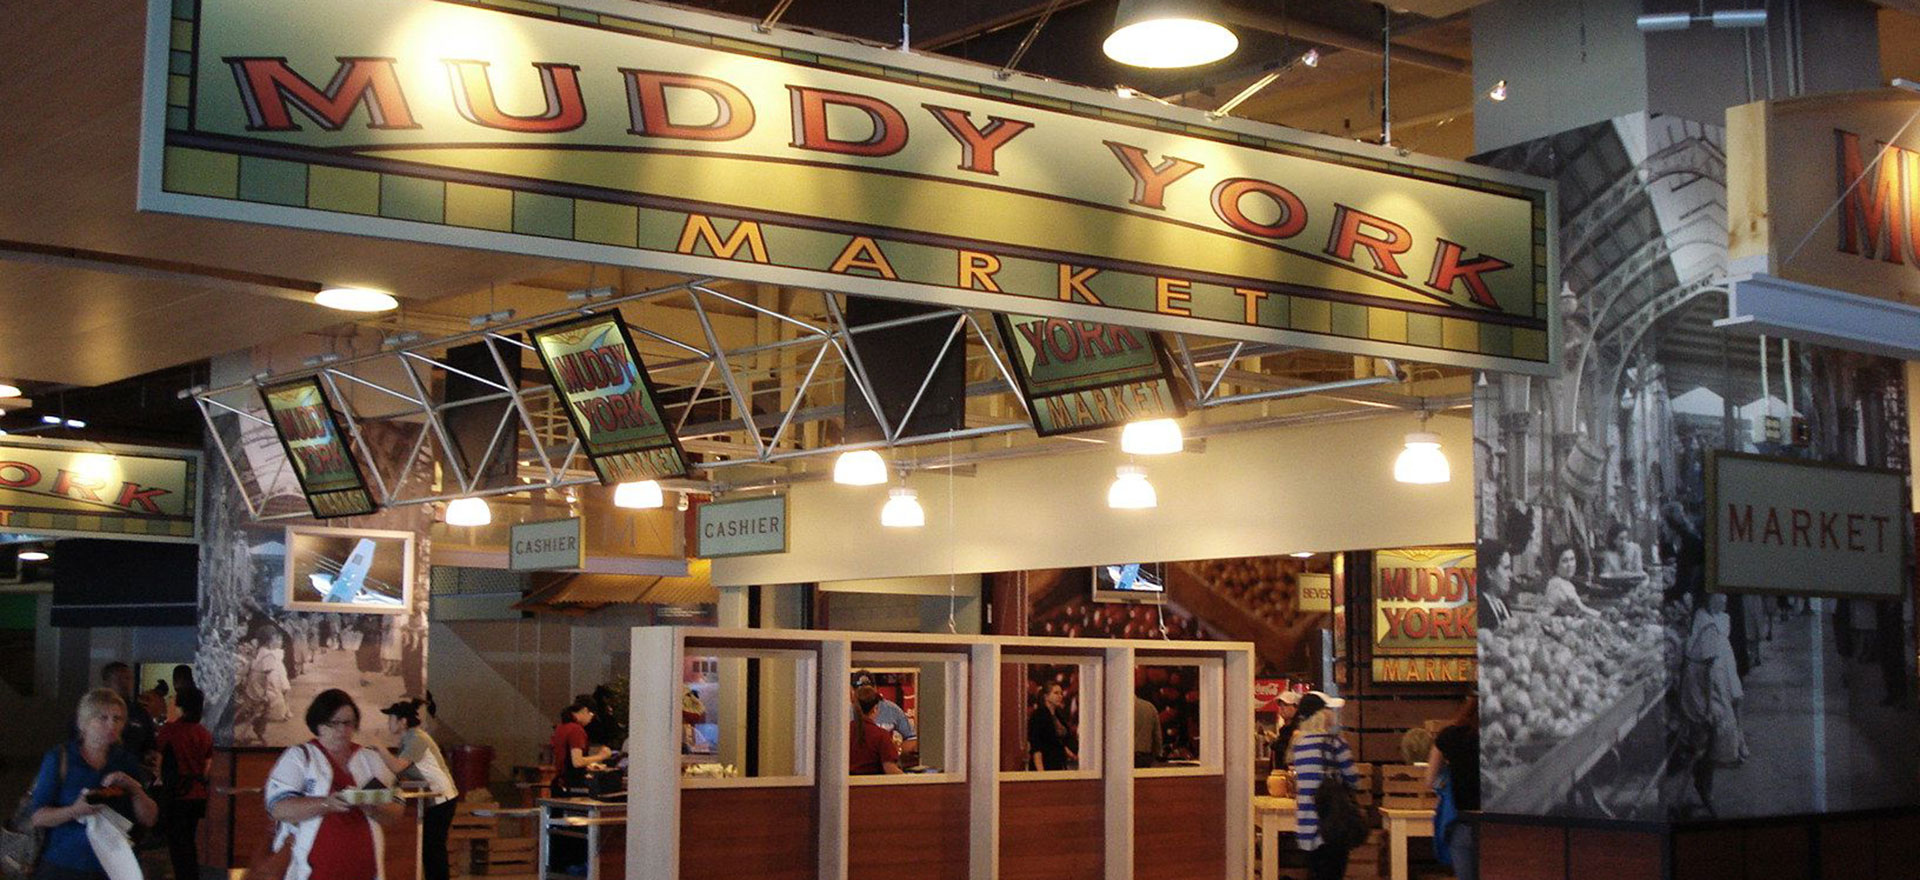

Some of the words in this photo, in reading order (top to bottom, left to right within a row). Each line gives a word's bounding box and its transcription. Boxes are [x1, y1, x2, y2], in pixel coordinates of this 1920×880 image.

[222, 56, 1035, 176] MUDDY
[1102, 139, 1514, 310] YORK
[676, 212, 1269, 325] MARKET
[552, 343, 636, 394] MUDDY
[573, 390, 658, 432] YORK
[1045, 380, 1165, 430] MARKET
[515, 536, 576, 555] CASHIER
[705, 516, 780, 538] CASHIER
[1728, 503, 1889, 552] MARKET
[1381, 606, 1477, 639] YORK
